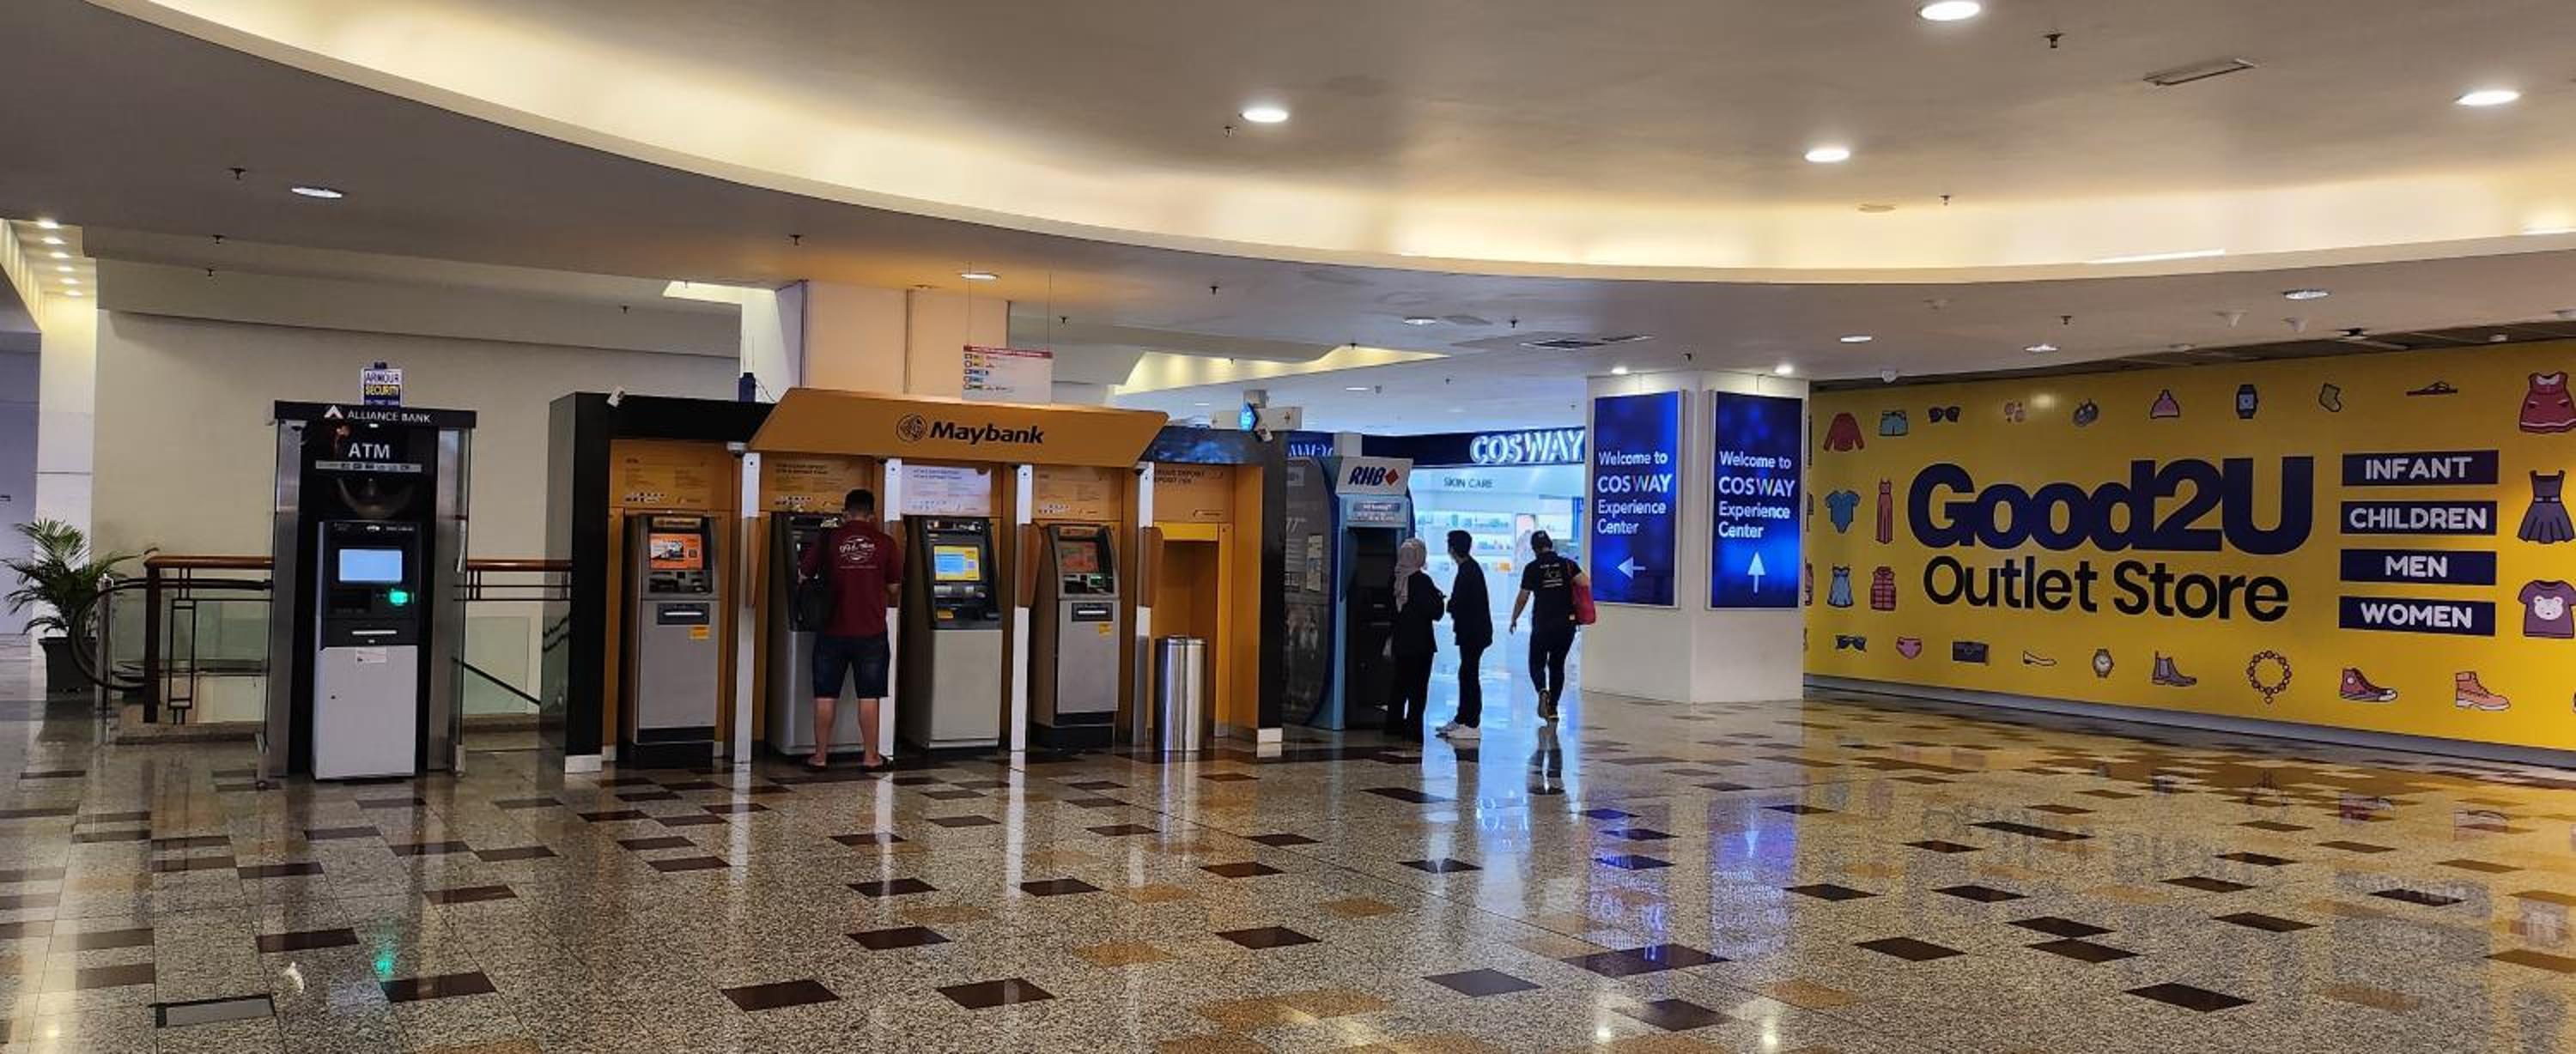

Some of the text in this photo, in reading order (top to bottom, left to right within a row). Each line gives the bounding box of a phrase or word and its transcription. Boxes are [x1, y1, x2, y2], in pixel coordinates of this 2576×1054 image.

[347, 409, 430, 423] ALLIANCE BANK
[929, 421, 1044, 445] Maybank
[348, 442, 391, 459] ATM
[1469, 429, 1585, 463] COSWAY
[1598, 451, 1668, 466] Welcome to
[1720, 451, 1792, 469] Welcome to
[2365, 457, 2472, 480] INFANT
[1348, 466, 1387, 487] RHB
[1443, 476, 1494, 488] SKIN CARE
[1597, 474, 1673, 494] COSWAY
[1718, 476, 1795, 498] COSWAY
[1598, 499, 1667, 518] Experience
[1719, 500, 1791, 521] Experience
[1907, 456, 2314, 554] Good2U
[1597, 518, 1639, 534] Center
[2349, 506, 2487, 530] CHILDREN
[1718, 521, 1765, 538] Center
[2385, 555, 2447, 578] MEN
[1923, 555, 2289, 622] Outlet Store
[2360, 603, 2473, 628] WOMEN
